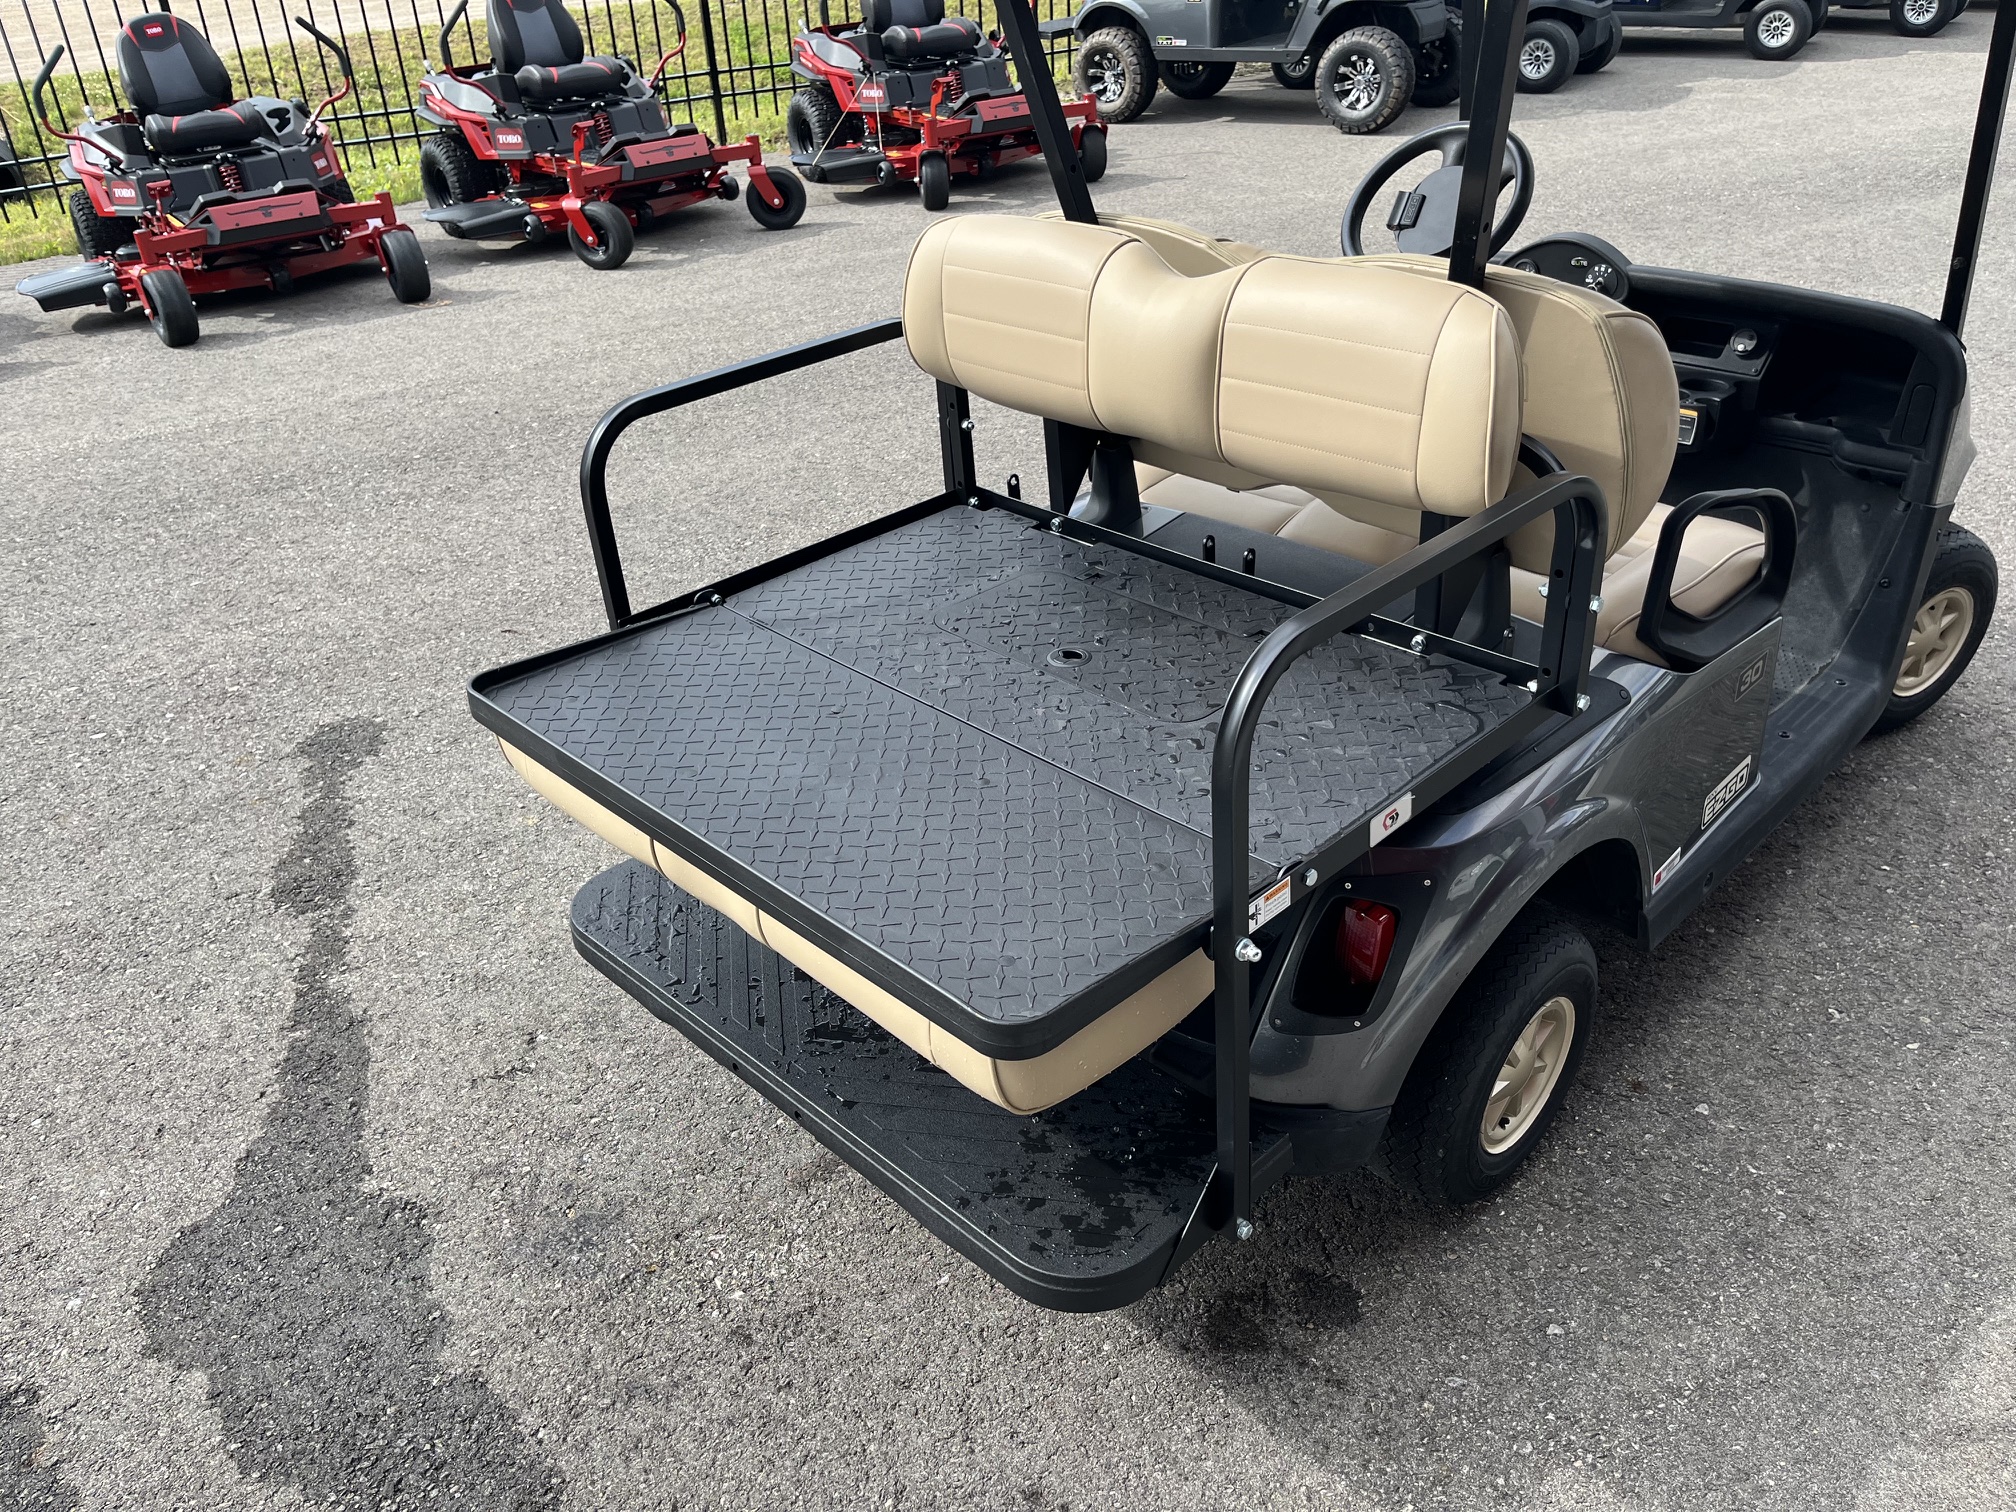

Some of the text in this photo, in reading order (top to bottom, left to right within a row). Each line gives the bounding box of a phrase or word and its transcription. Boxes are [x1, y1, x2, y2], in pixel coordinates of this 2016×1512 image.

[861, 89, 883, 98] TORO
[496, 134, 522, 144] TORO
[113, 188, 136, 198] TORO
[1740, 659, 1764, 692] 30
